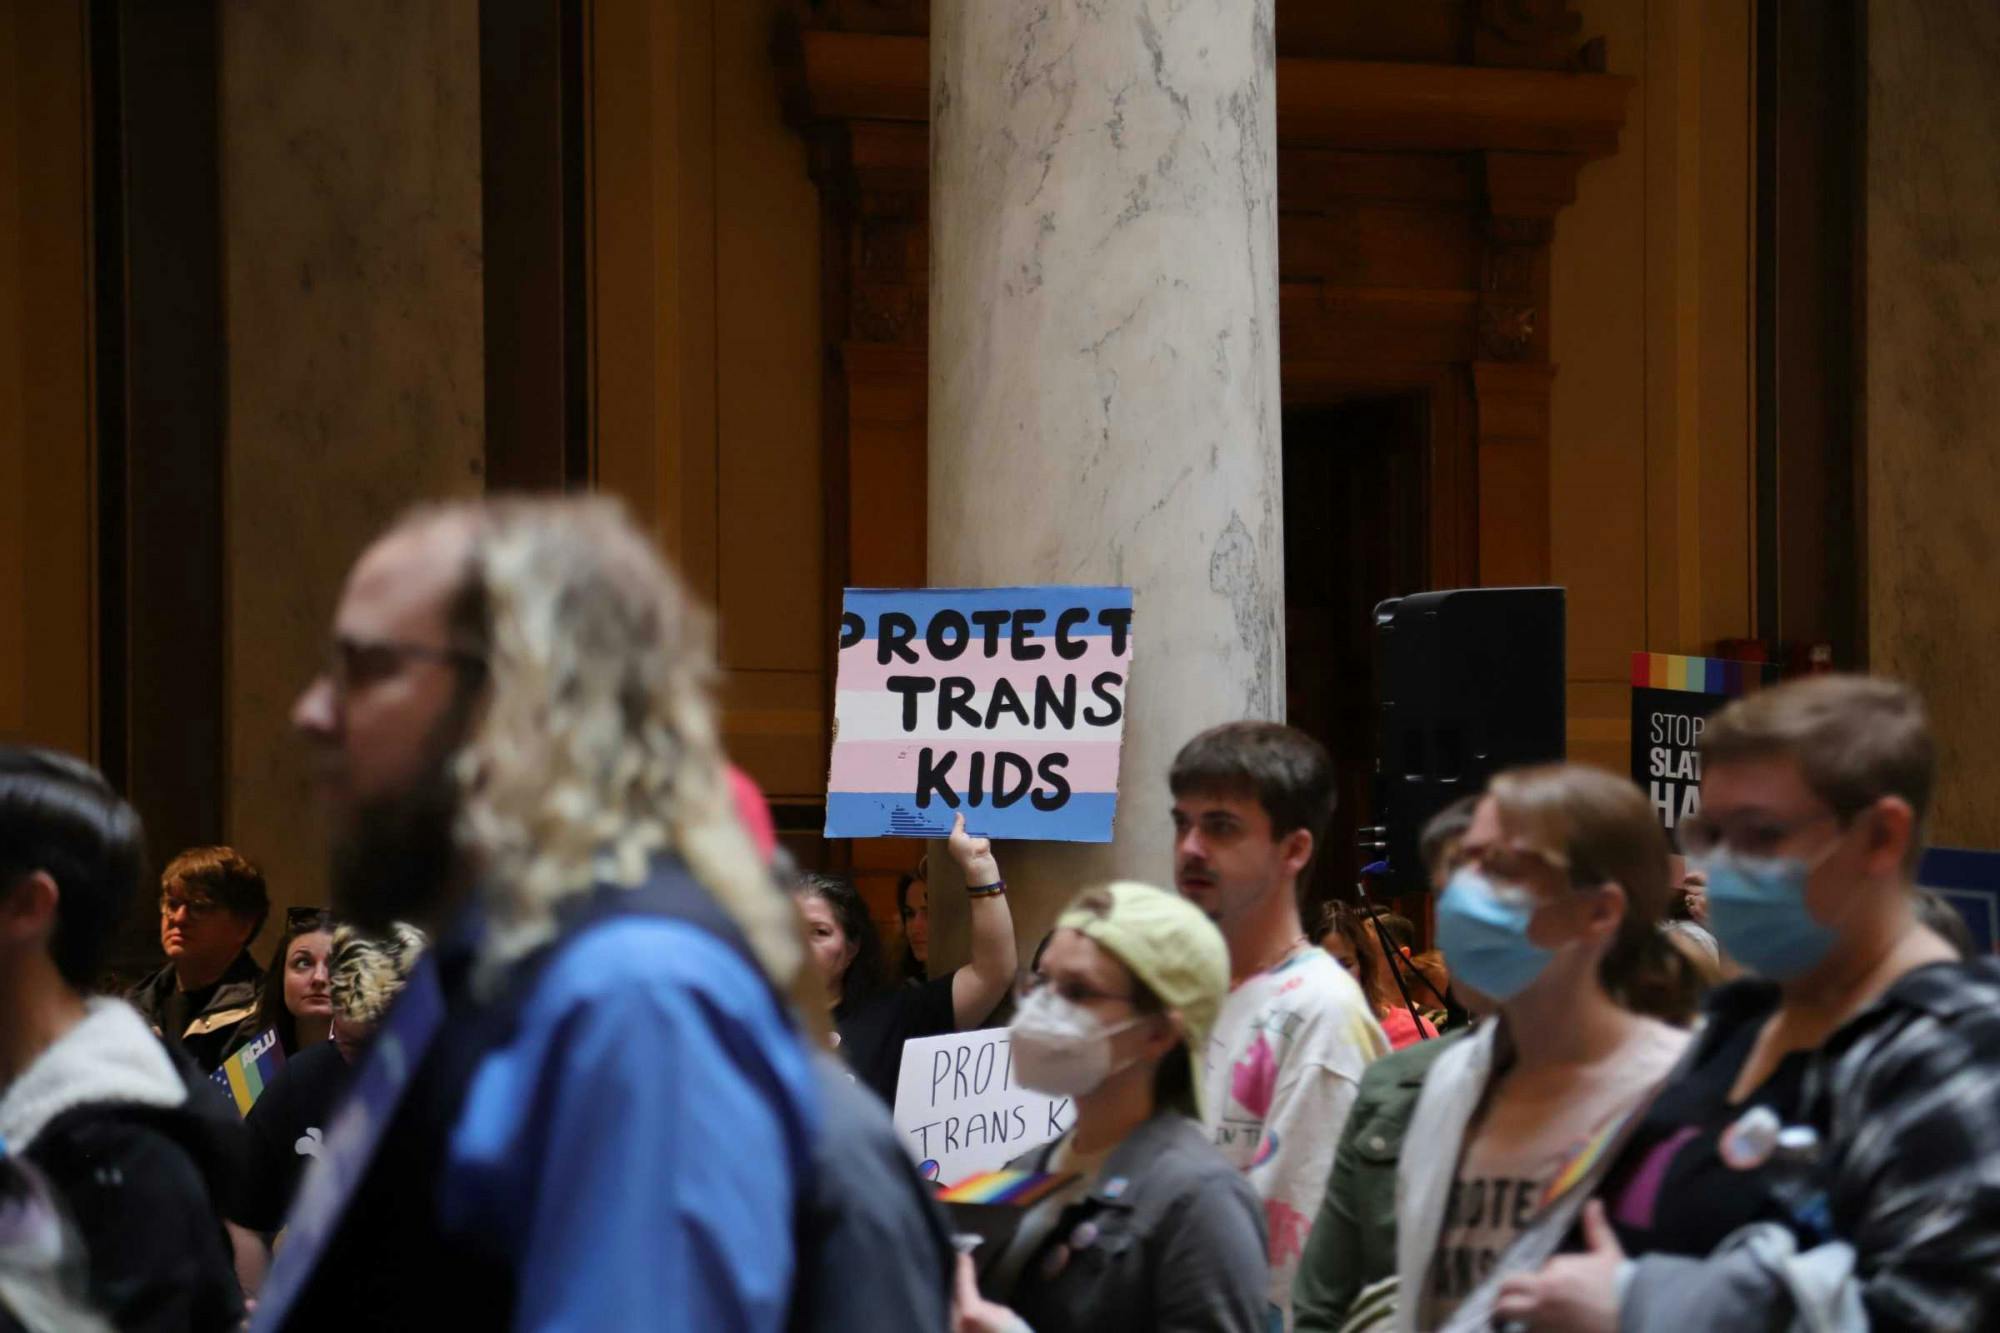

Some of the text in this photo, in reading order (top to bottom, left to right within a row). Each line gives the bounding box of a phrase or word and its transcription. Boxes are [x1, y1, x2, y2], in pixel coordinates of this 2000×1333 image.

[840, 608, 1132, 665] PROTECT
[887, 672, 1123, 732] TRANS
[1651, 712, 1705, 747] STOP
[916, 748, 1071, 811] KIDS
[242, 1029, 276, 1068] ACLU
[932, 1040, 1012, 1107] PROT
[911, 1098, 1068, 1158] TRANS K
